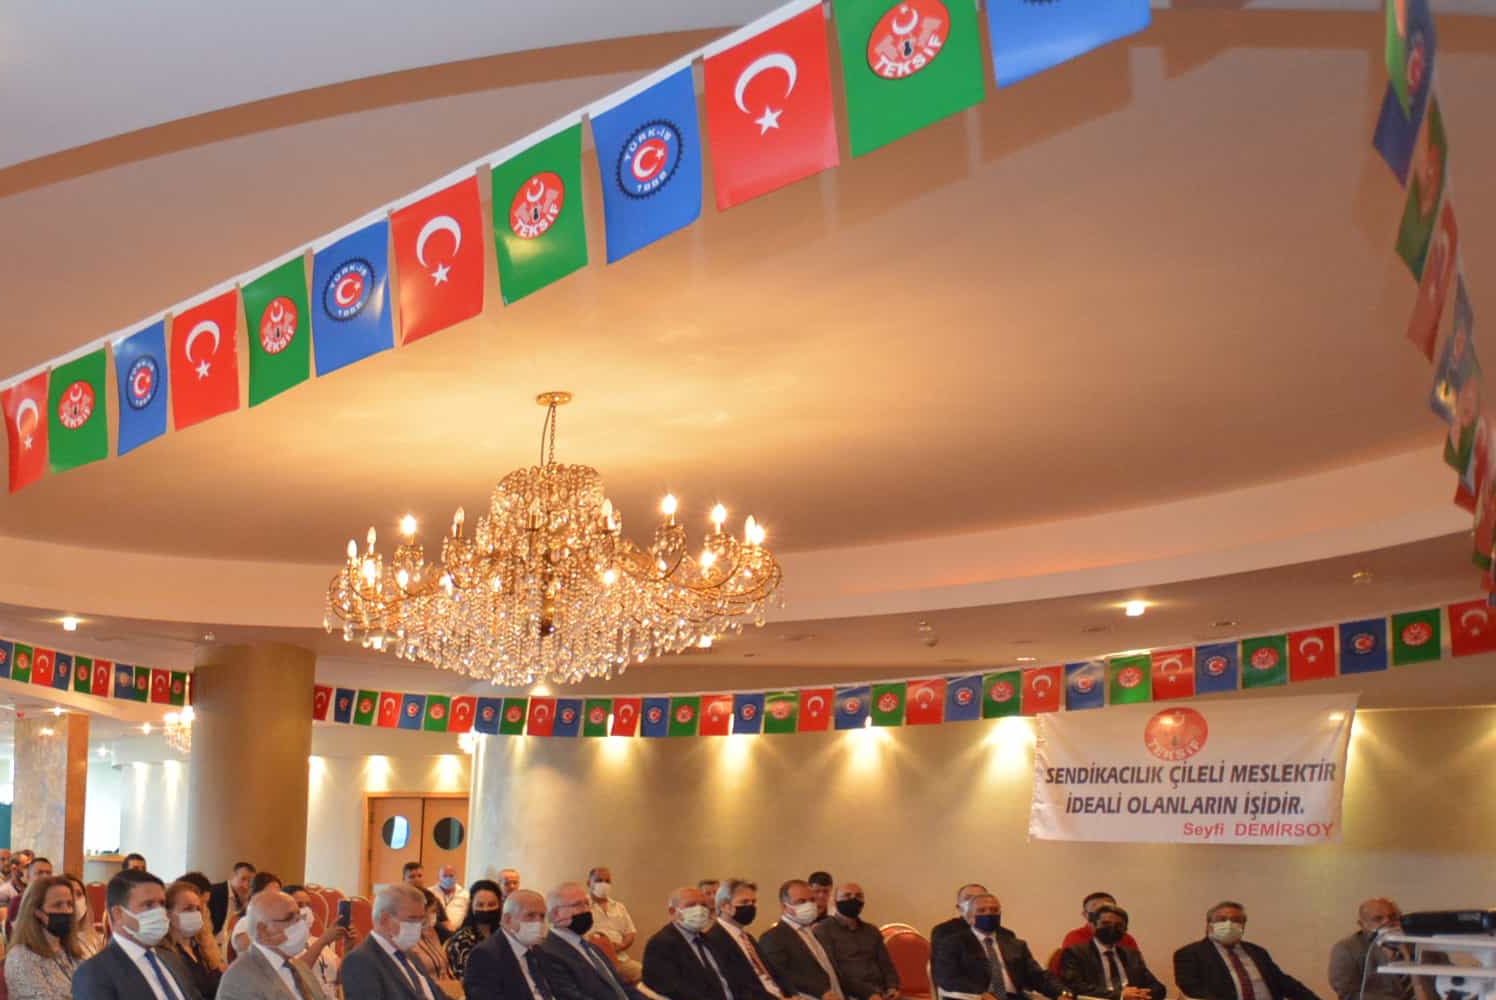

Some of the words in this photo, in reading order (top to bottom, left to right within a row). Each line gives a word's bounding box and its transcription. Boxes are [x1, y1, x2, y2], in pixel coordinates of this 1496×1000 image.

[1045, 762, 1165, 785] SENDİKACILIK
[1169, 760, 1225, 788] ÇİLELİ
[1230, 757, 1337, 784] MESLEKTİR
[1066, 792, 1121, 814] İDEALİ
[1127, 795, 1238, 815] OLANLARIN
[1243, 791, 1305, 819] İŞİDİR.
[1183, 822, 1225, 839] Seyfi
[1234, 820, 1334, 838] DEMİRSOY
